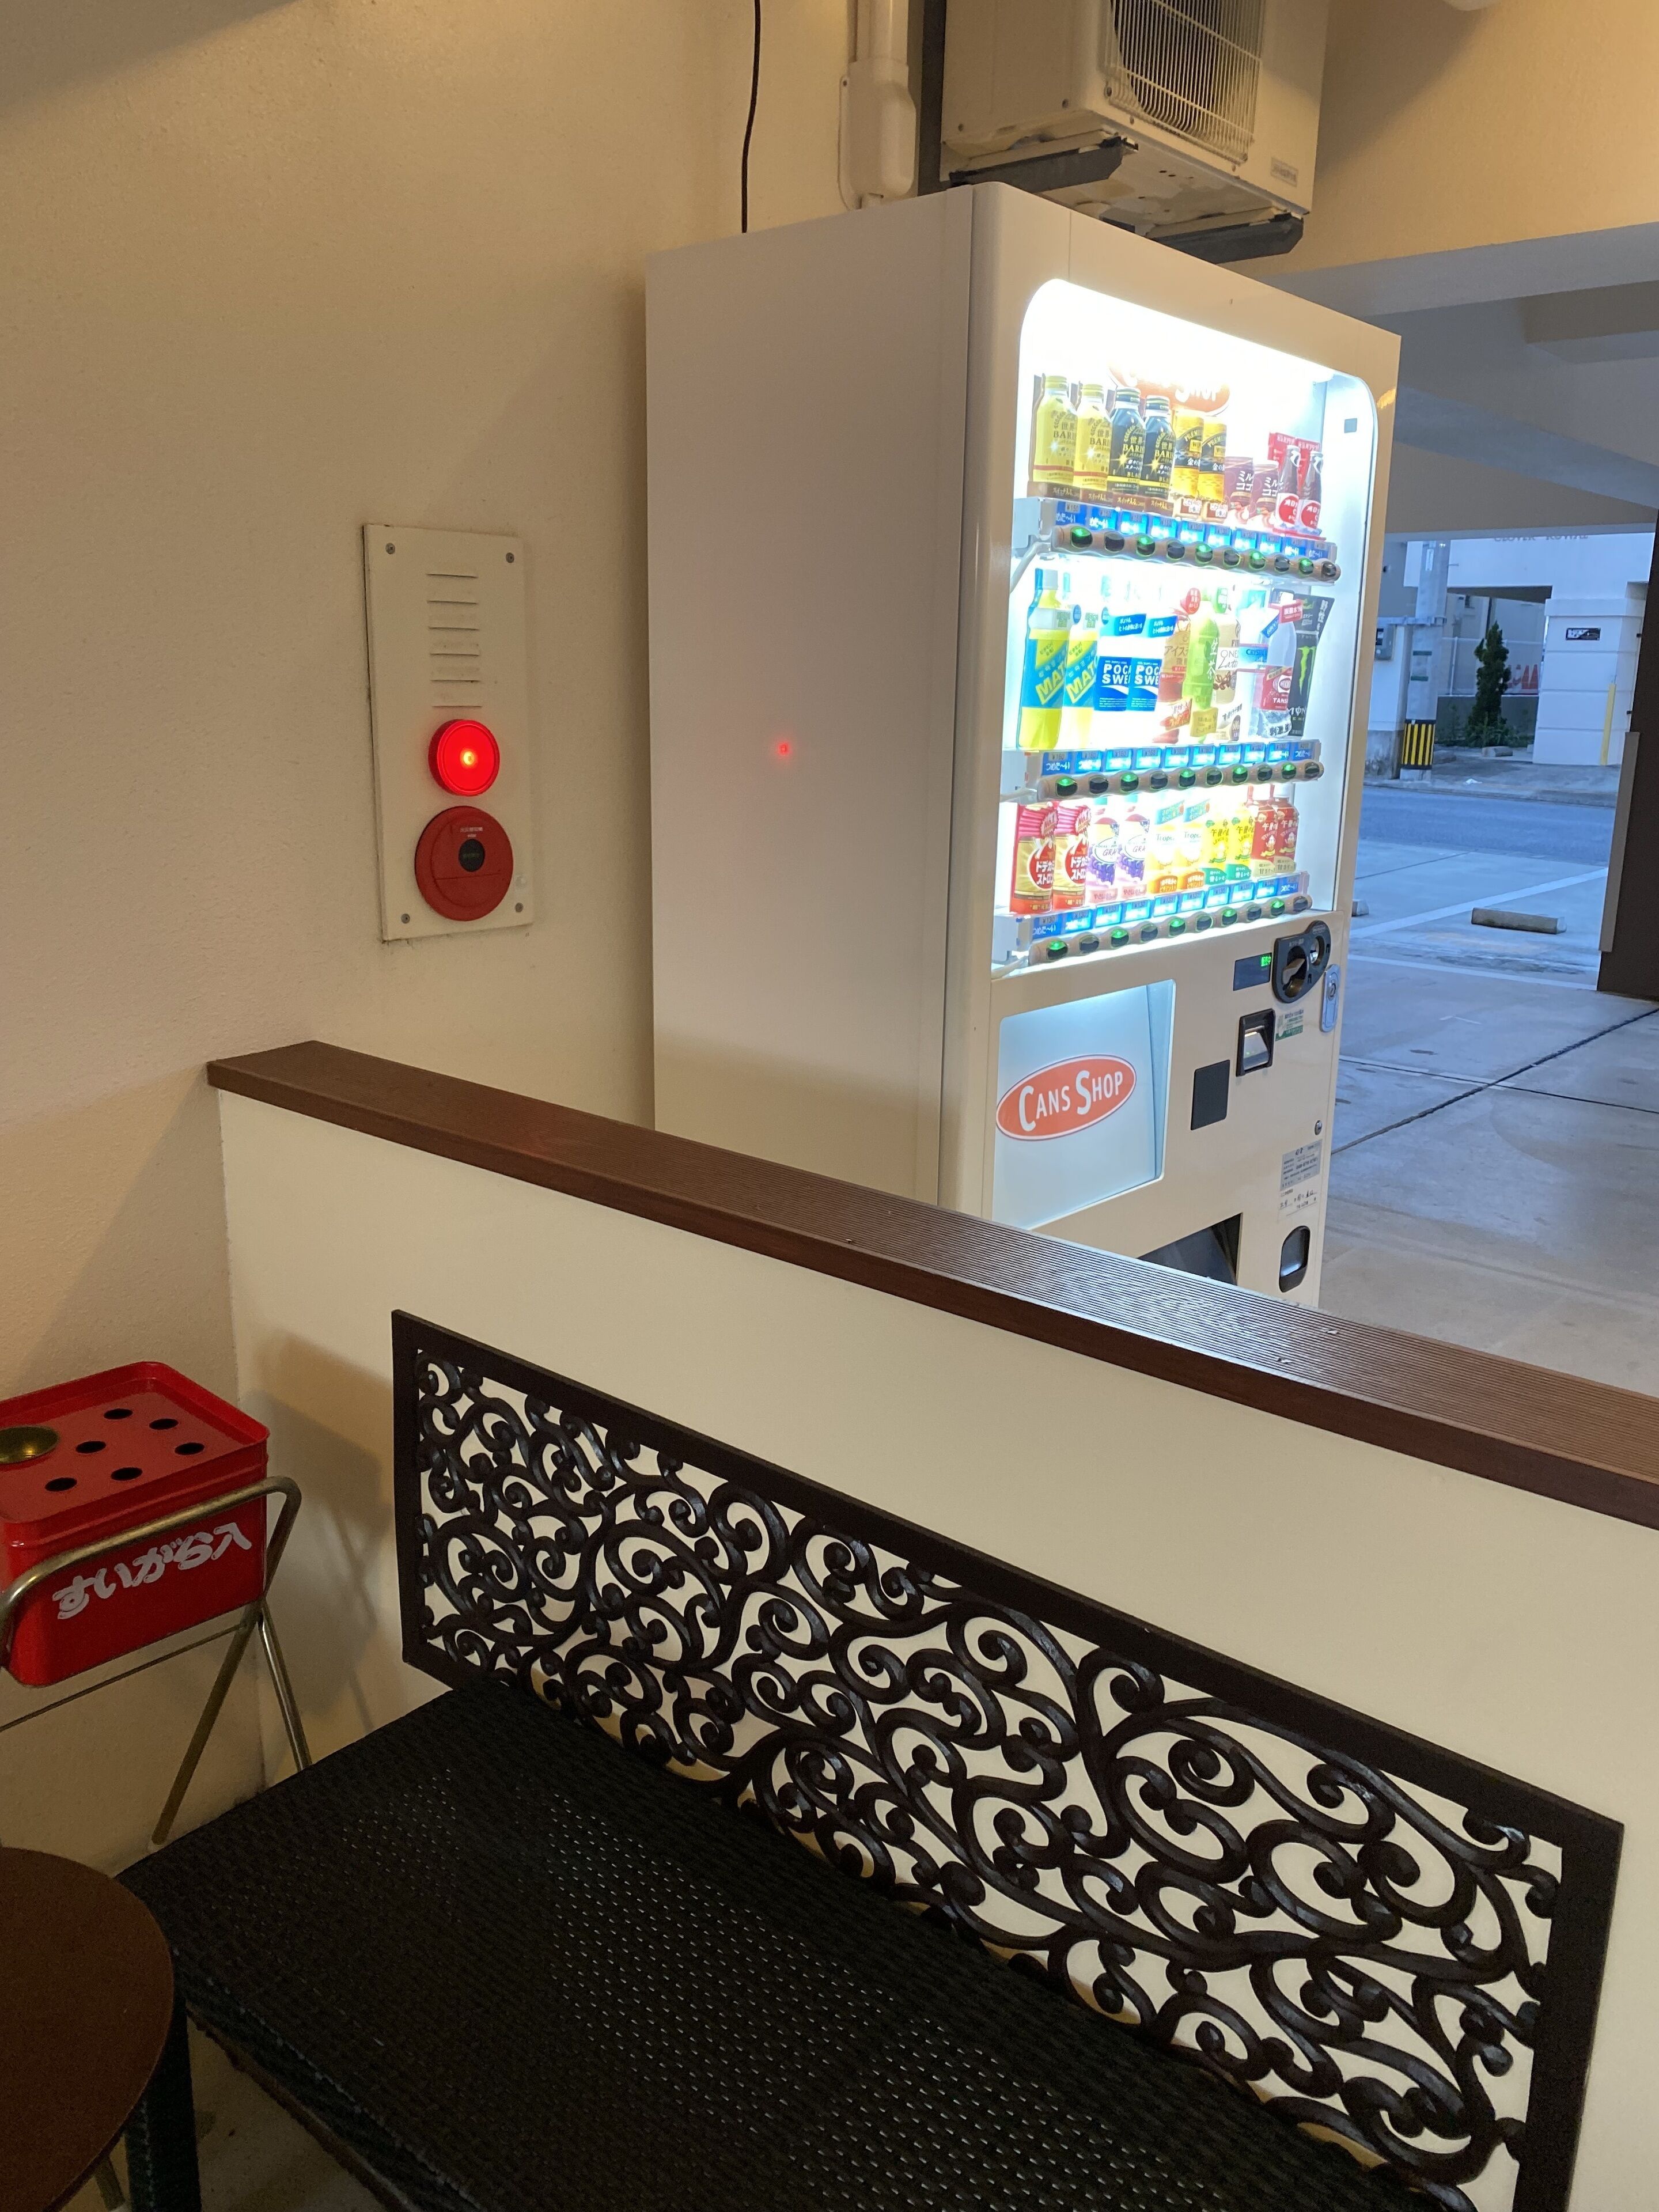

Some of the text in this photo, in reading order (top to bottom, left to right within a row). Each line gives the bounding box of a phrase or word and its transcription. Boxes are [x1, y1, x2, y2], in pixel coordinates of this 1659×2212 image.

[1018, 1070, 1123, 1132] CANS SHOP
[52, 1522, 252, 1620] すいがら入
